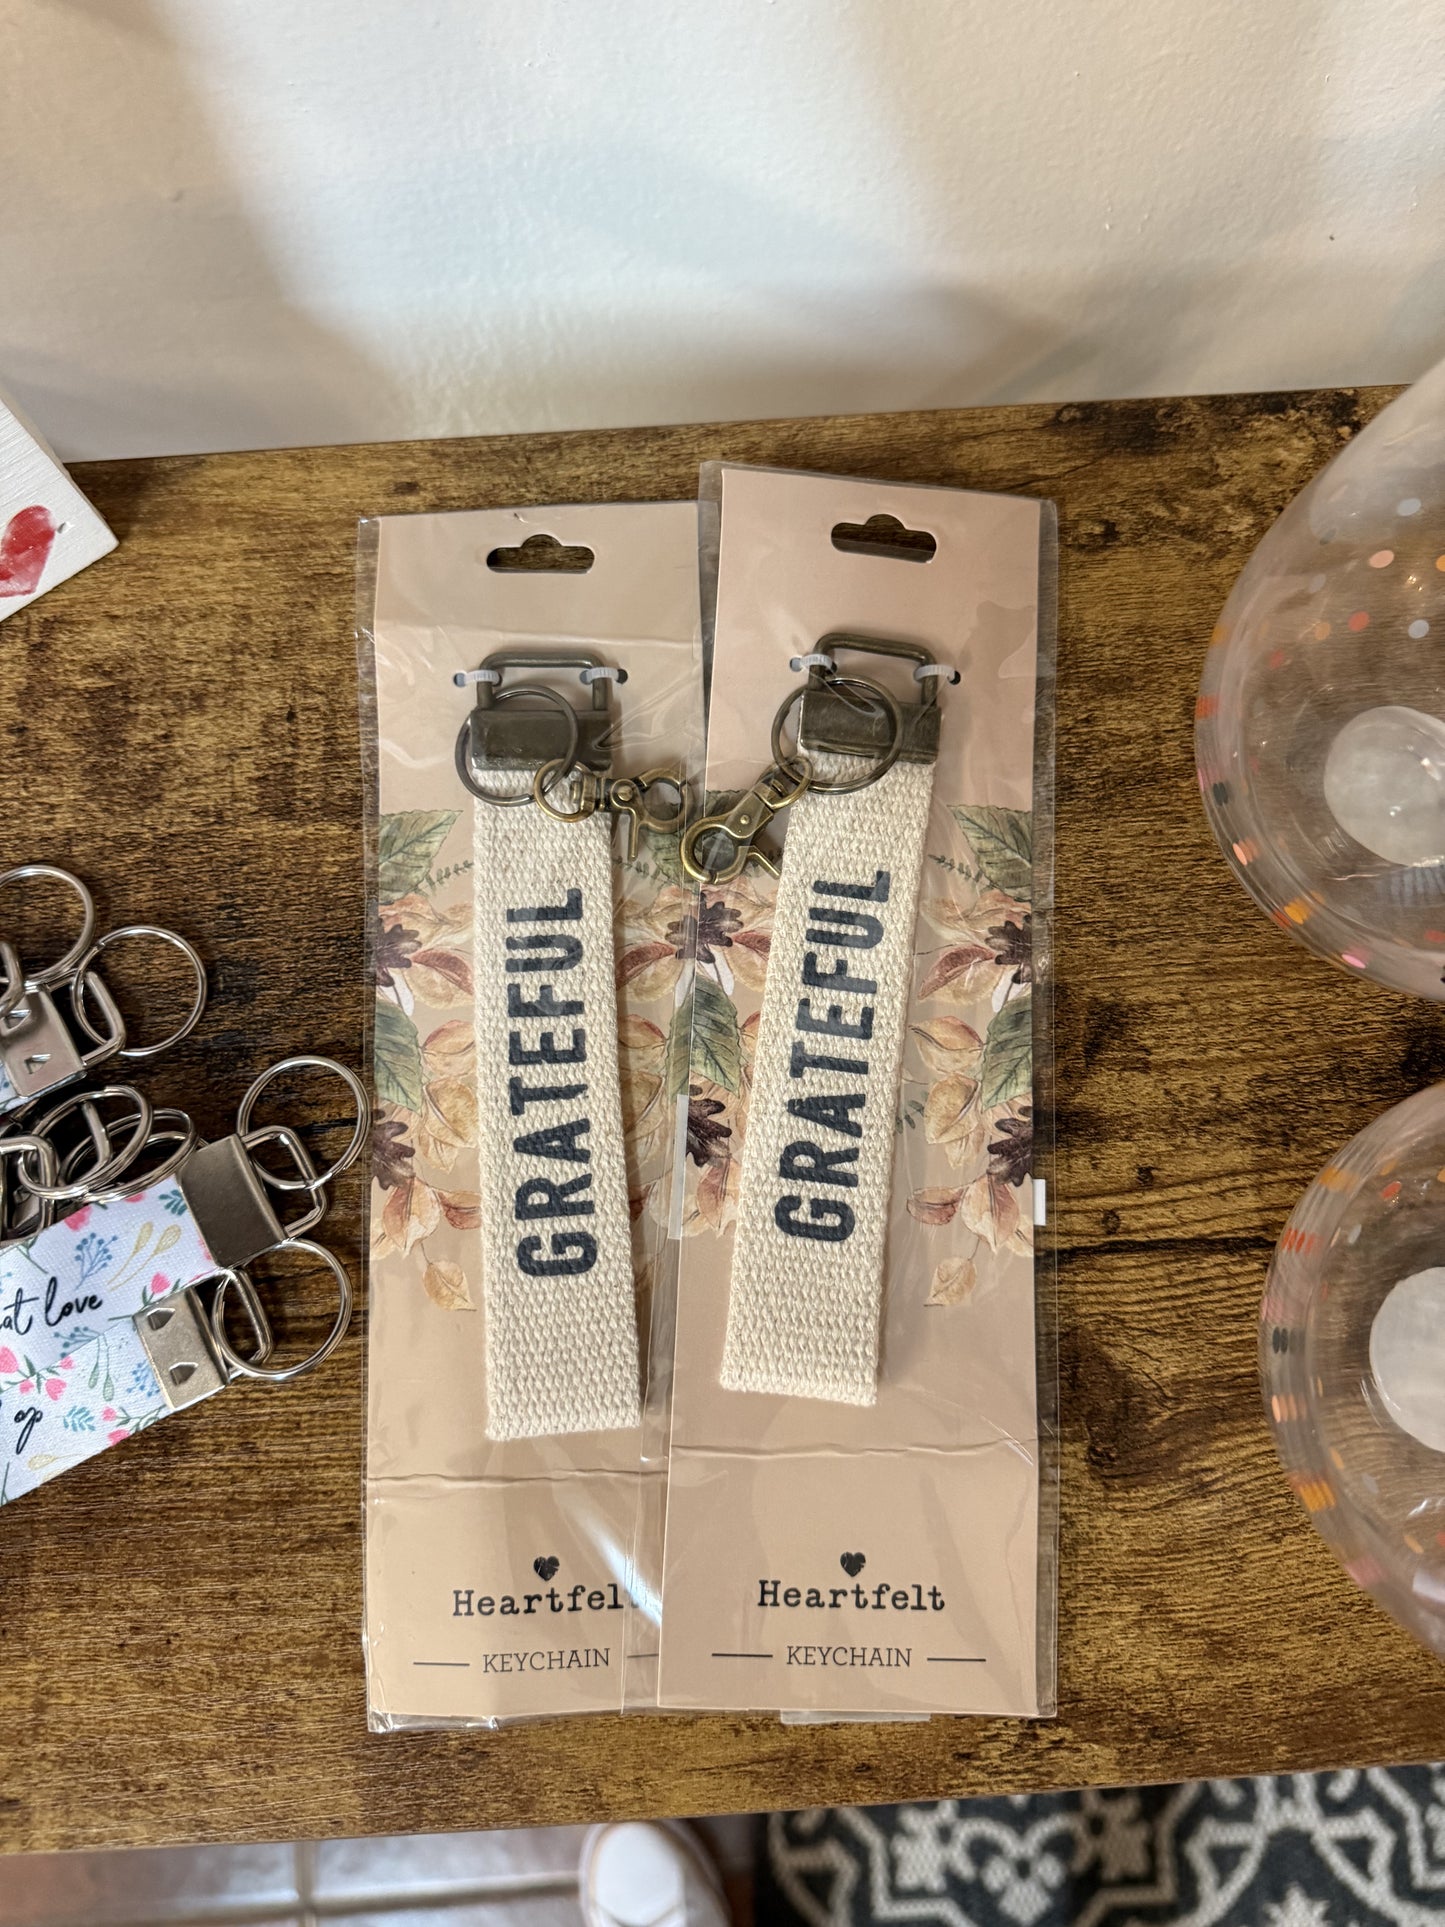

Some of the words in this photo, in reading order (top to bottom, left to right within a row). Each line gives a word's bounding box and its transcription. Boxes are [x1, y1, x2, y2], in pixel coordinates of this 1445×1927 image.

[775, 870, 891, 1242] GRATEFUL
[505, 888, 597, 1277] GRATEFUL
[0, 1287, 40, 1335] at
[44, 1276, 103, 1327] love
[6, 1404, 43, 1455] op
[452, 1583, 640, 1616] Heartfel
[757, 1579, 946, 1612] Heartfelt
[482, 1648, 610, 1673] KEYCHAIN
[785, 1645, 913, 1668] KEYCHAIN
